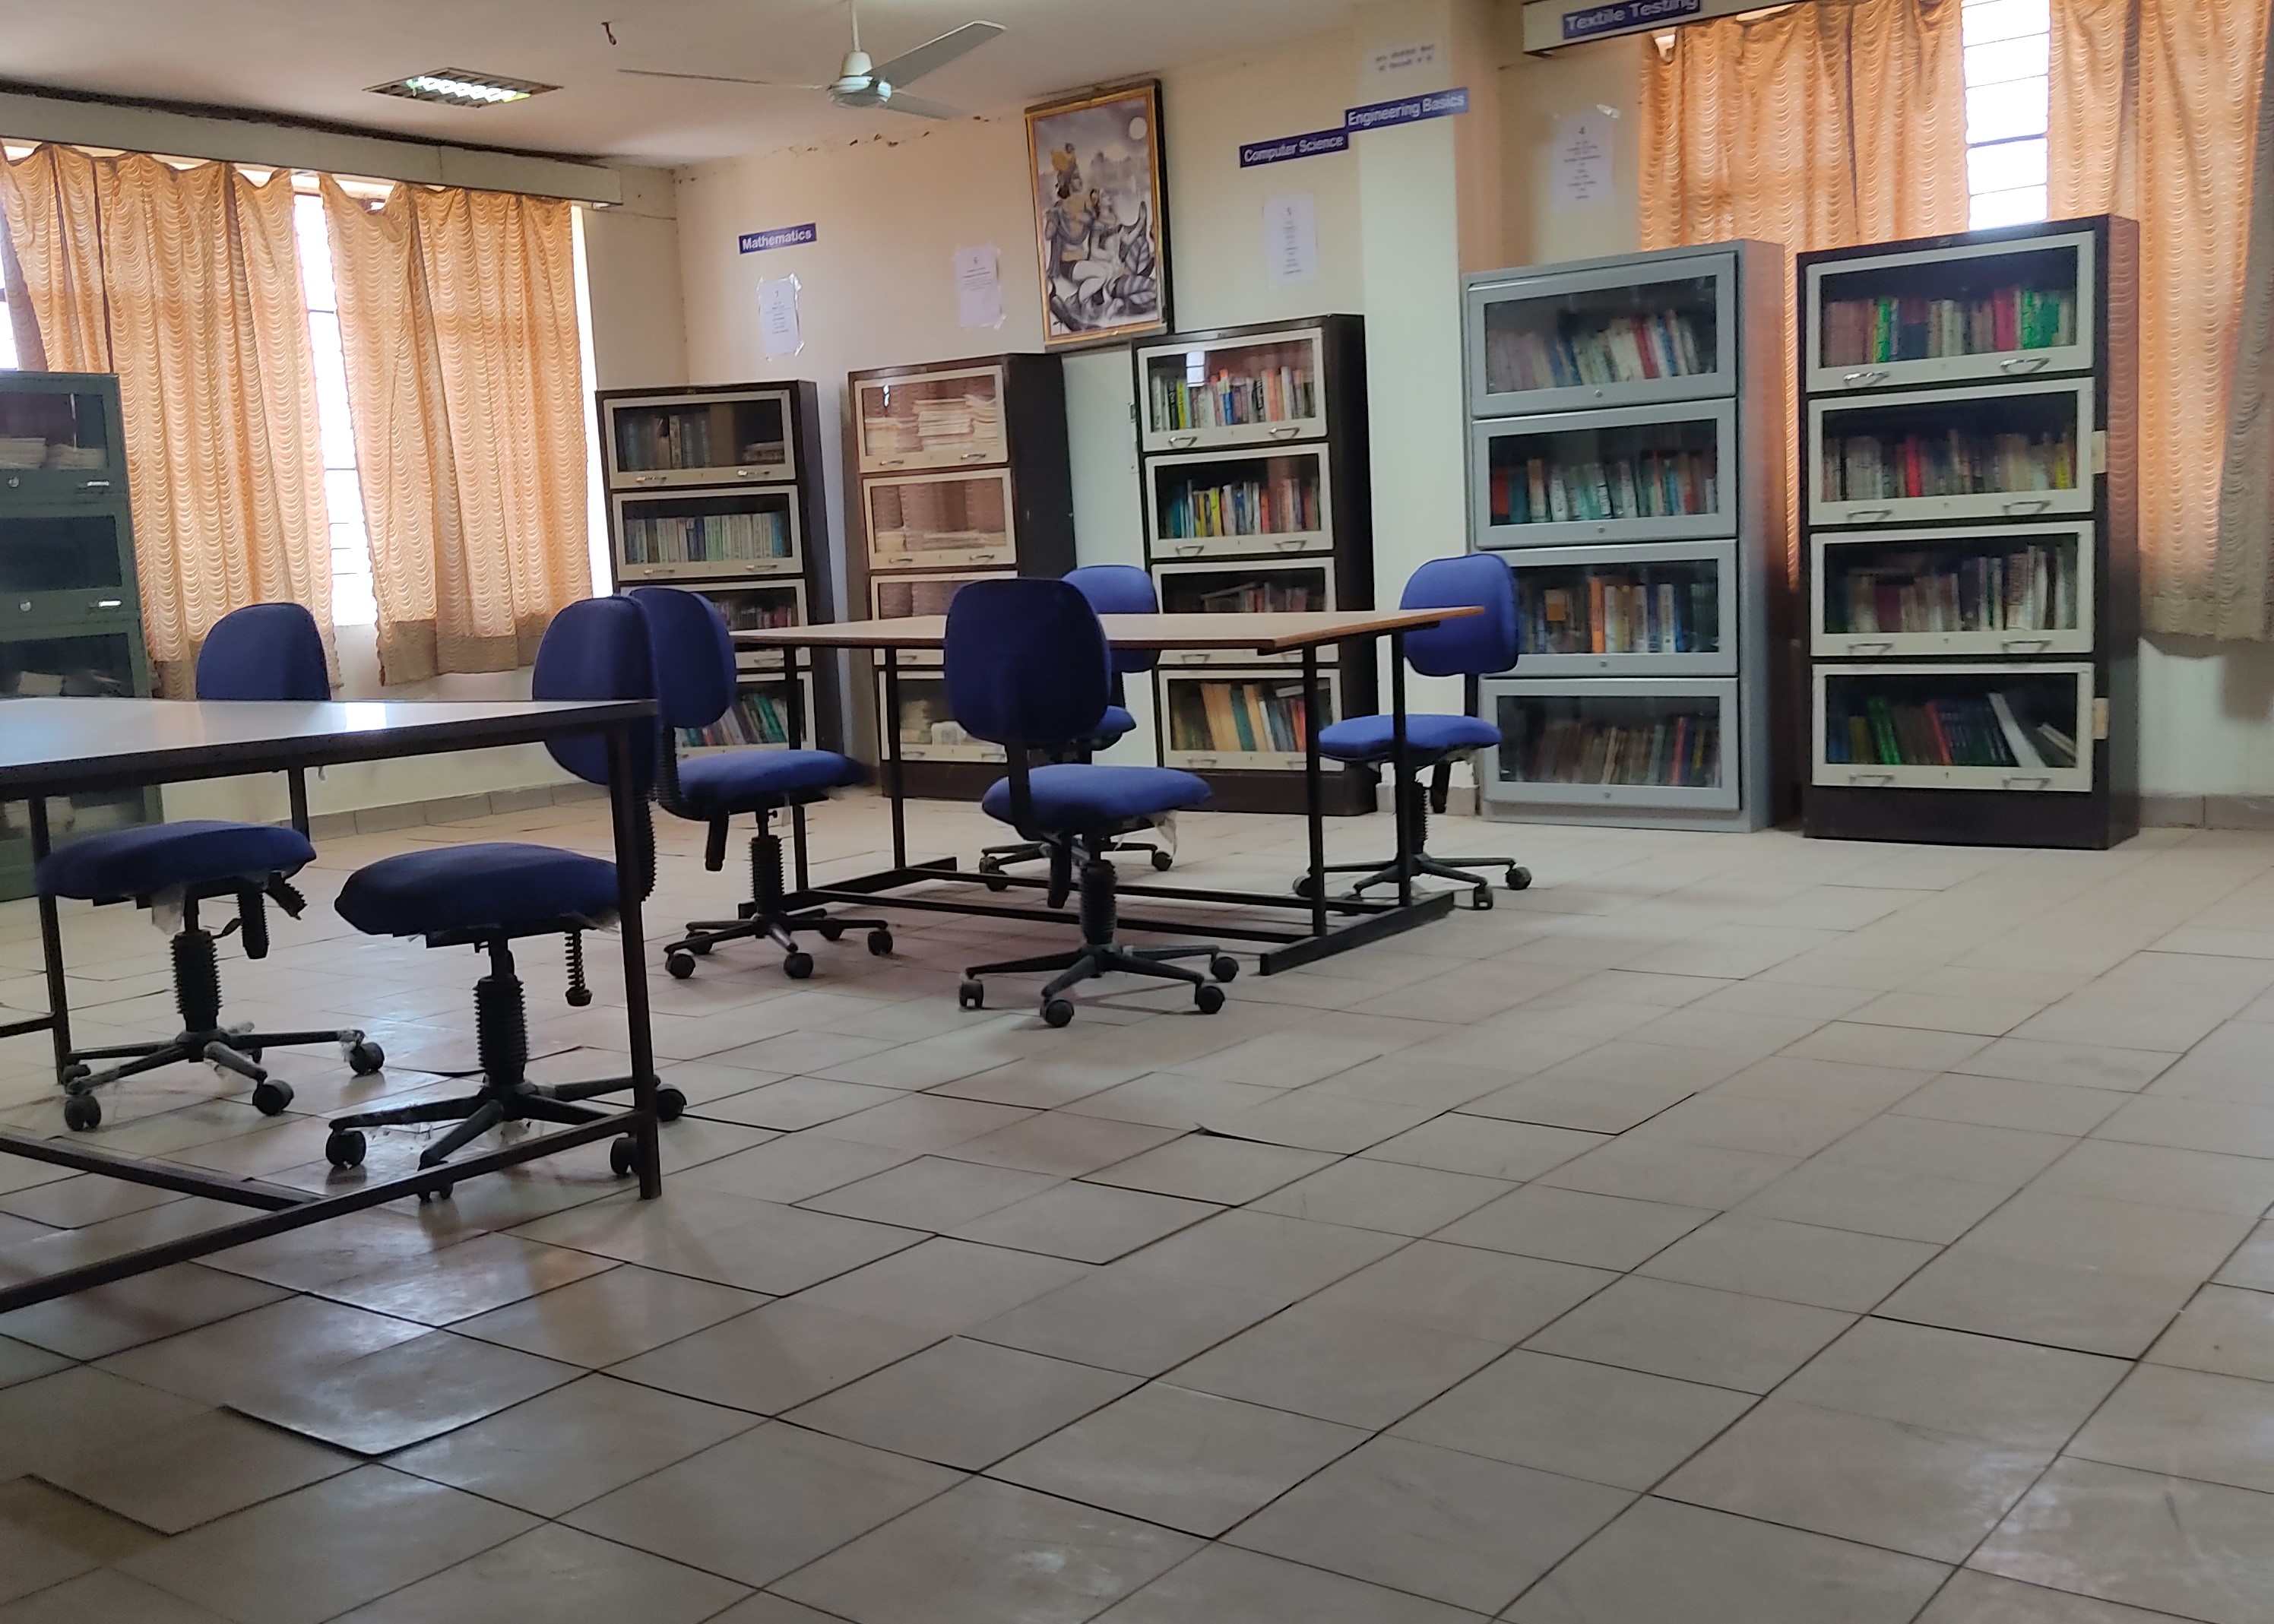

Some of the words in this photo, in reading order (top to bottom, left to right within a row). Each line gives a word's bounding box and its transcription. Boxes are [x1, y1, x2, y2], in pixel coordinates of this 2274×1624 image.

[1566, 8, 1626, 30] Textile
[1348, 102, 1420, 126] Engineering
[1422, 93, 1465, 112] Basics
[1244, 143, 1298, 163] Computer
[1299, 135, 1344, 153] Science
[742, 229, 812, 251] Mathematics
